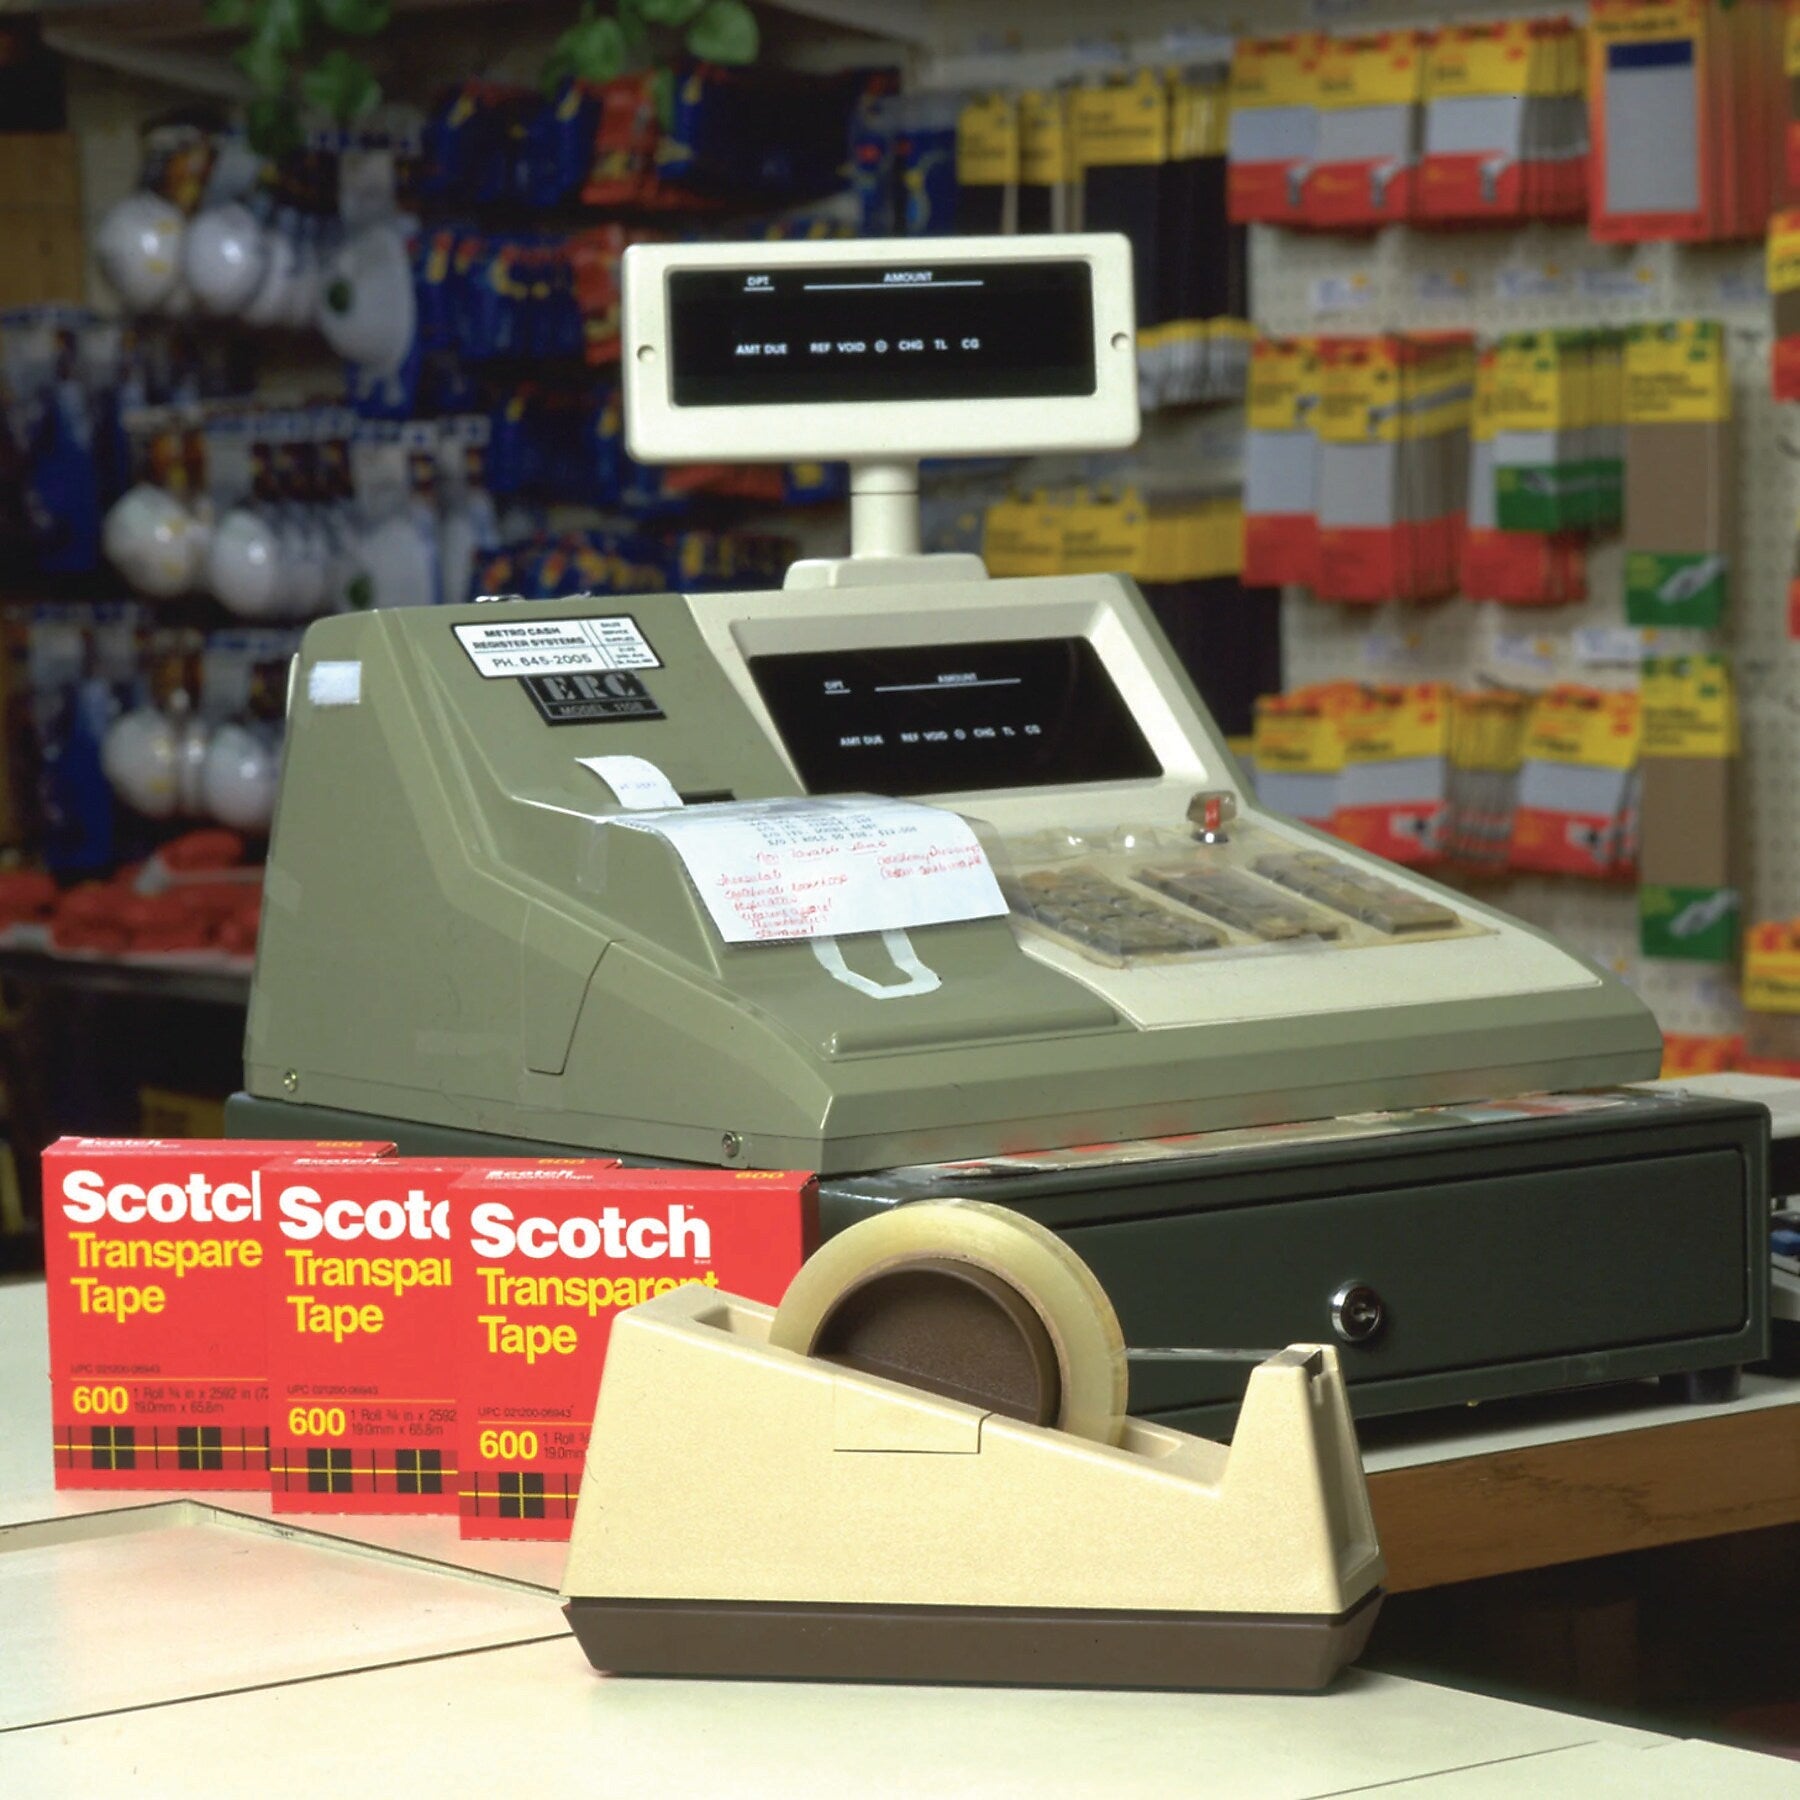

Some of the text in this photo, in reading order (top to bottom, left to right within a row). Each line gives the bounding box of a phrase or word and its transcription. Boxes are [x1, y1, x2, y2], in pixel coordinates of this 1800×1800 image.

[747, 276, 769, 286] DPT
[883, 271, 933, 283] AMOUNT
[735, 343, 761, 355] AMT
[763, 343, 788, 355] DUE
[810, 342, 831, 353] REF
[836, 341, 866, 353] VOID
[898, 340, 924, 351] CHG
[934, 338, 948, 350] TL
[484, 627, 561, 637] METRO CASH
[472, 637, 585, 649] REGISTER SYSTEMS
[937, 672, 977, 683] AMOUNT
[542, 671, 637, 700] ERC
[923, 731, 948, 741] VOID
[62, 1170, 262, 1223] Scotc
[471, 1202, 711, 1259] Scotch
[70, 1277, 166, 1323] Tape
[287, 1295, 384, 1343] Tape
[477, 1315, 578, 1364] Tape
[143, 1387, 164, 1399] Roll
[287, 1385, 309, 1394] UPC
[73, 1386, 129, 1414] 600
[361, 1409, 382, 1421] Roll
[429, 1409, 457, 1422] 2592
[478, 1407, 499, 1417] UPC
[289, 1407, 346, 1436] 600
[480, 1430, 538, 1459] 600
[554, 1432, 575, 1444] Roll
